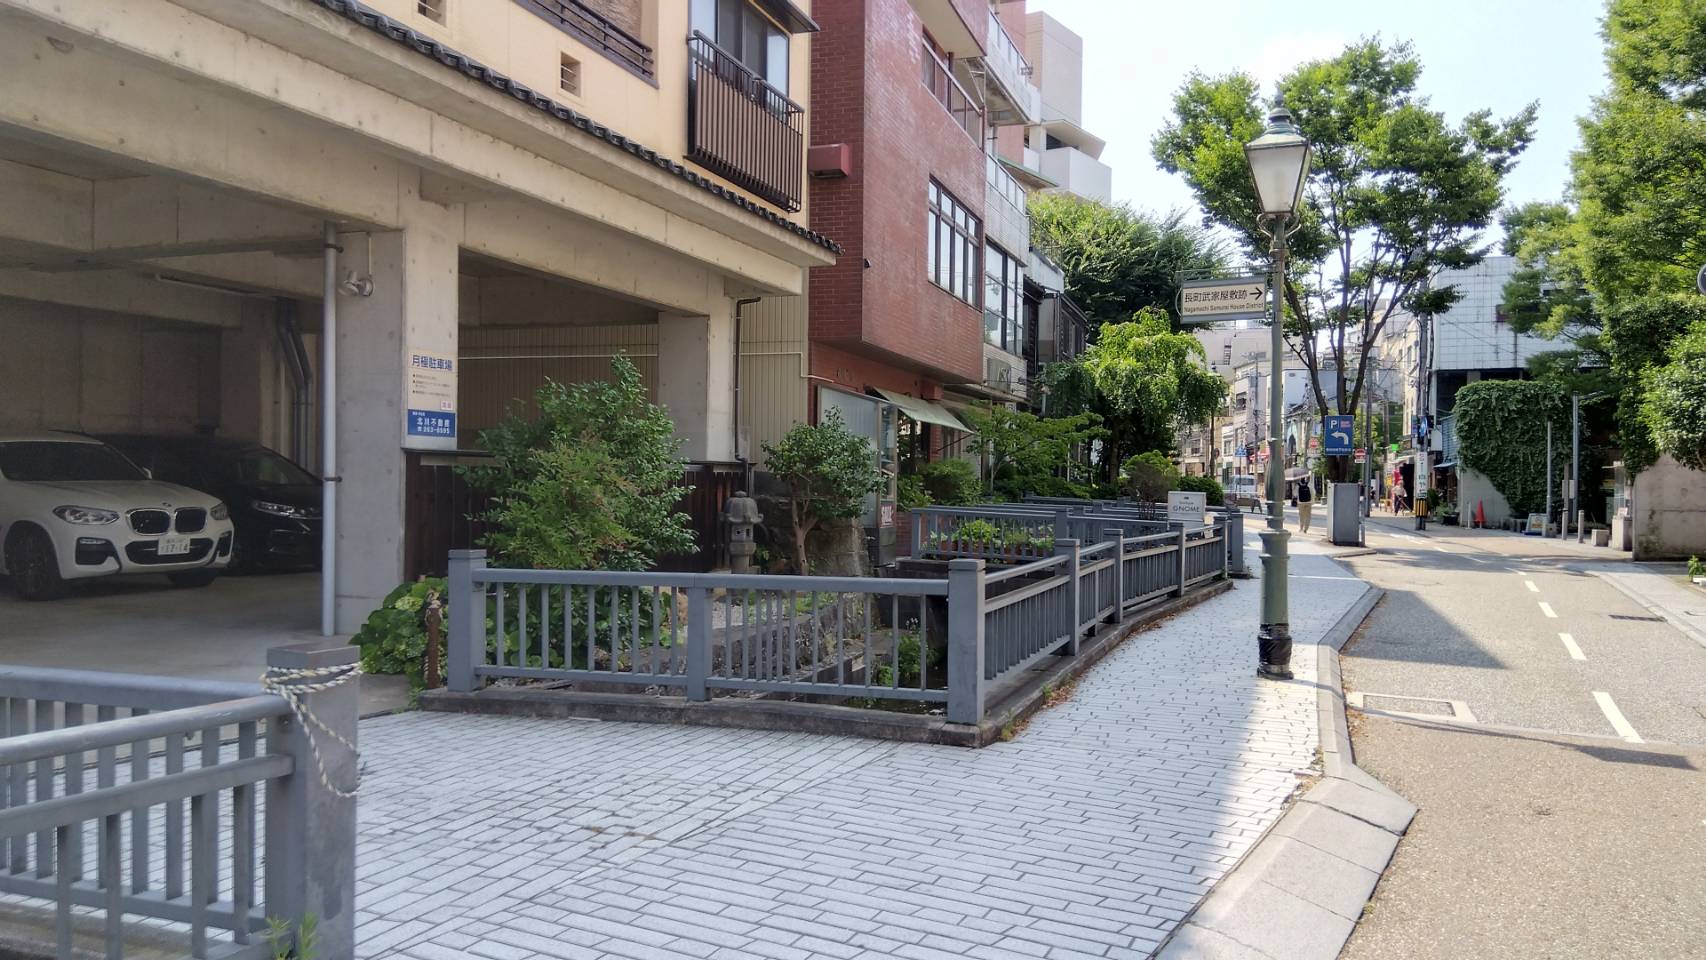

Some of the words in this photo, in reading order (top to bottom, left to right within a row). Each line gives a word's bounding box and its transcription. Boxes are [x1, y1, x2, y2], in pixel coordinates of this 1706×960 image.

[1185, 290, 1247, 302] 長町武家屋敷跡
[412, 355, 453, 371] 月極駐車場
[1331, 420, 1338, 429] P
